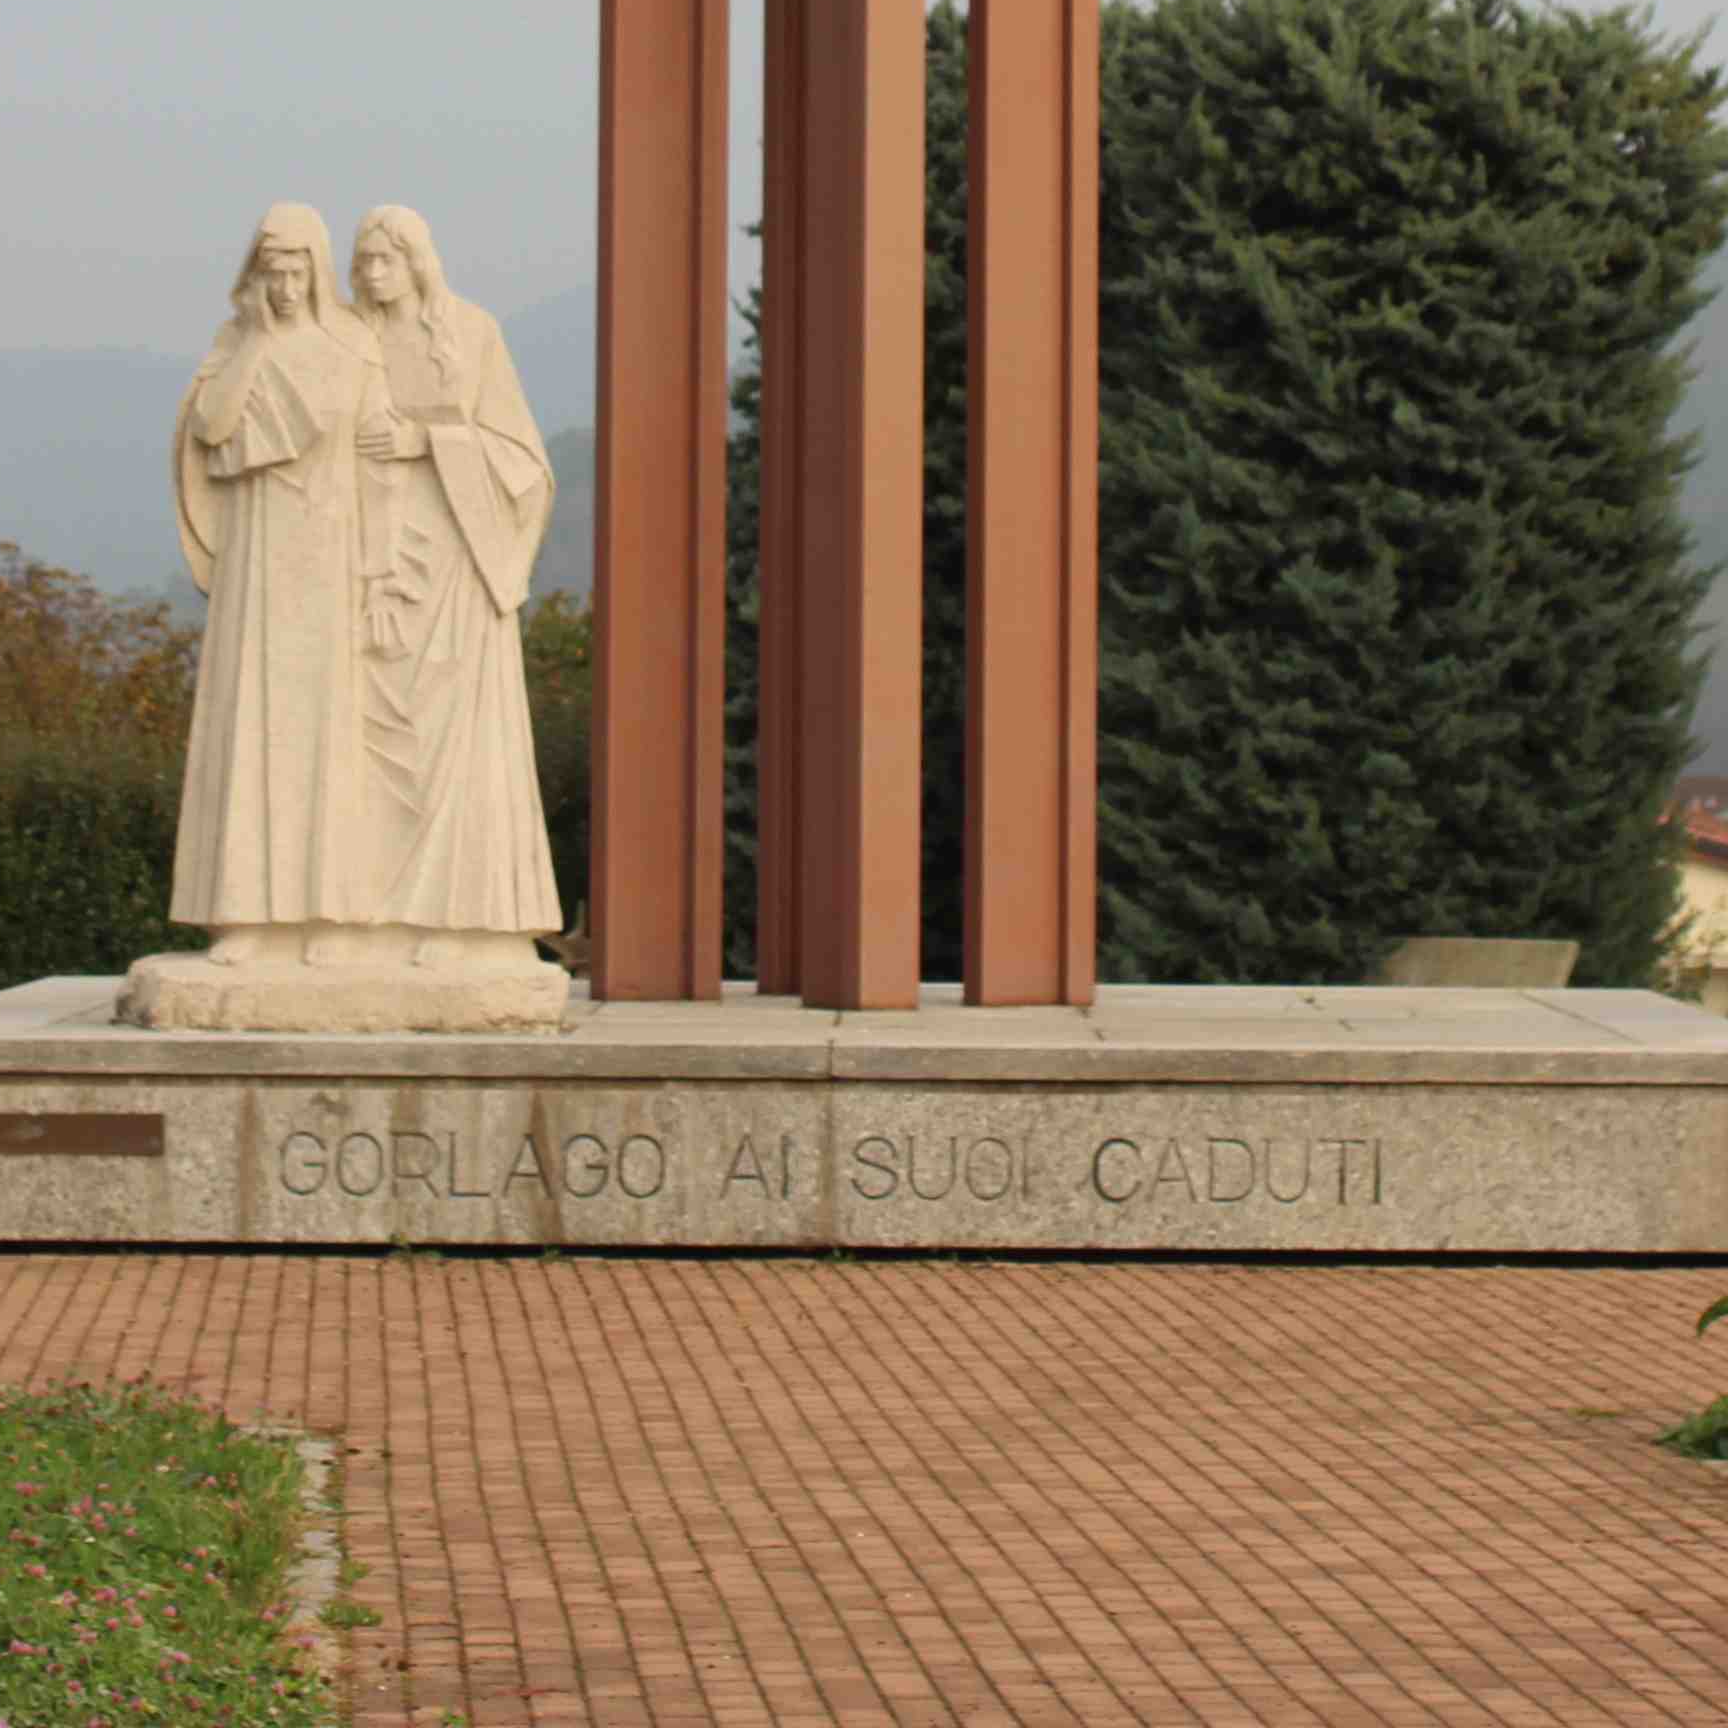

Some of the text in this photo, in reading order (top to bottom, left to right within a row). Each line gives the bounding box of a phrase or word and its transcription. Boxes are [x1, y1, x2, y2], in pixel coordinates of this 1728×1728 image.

[277, 1130, 1383, 1206] GORLAGO AI SUOI CADUTI
